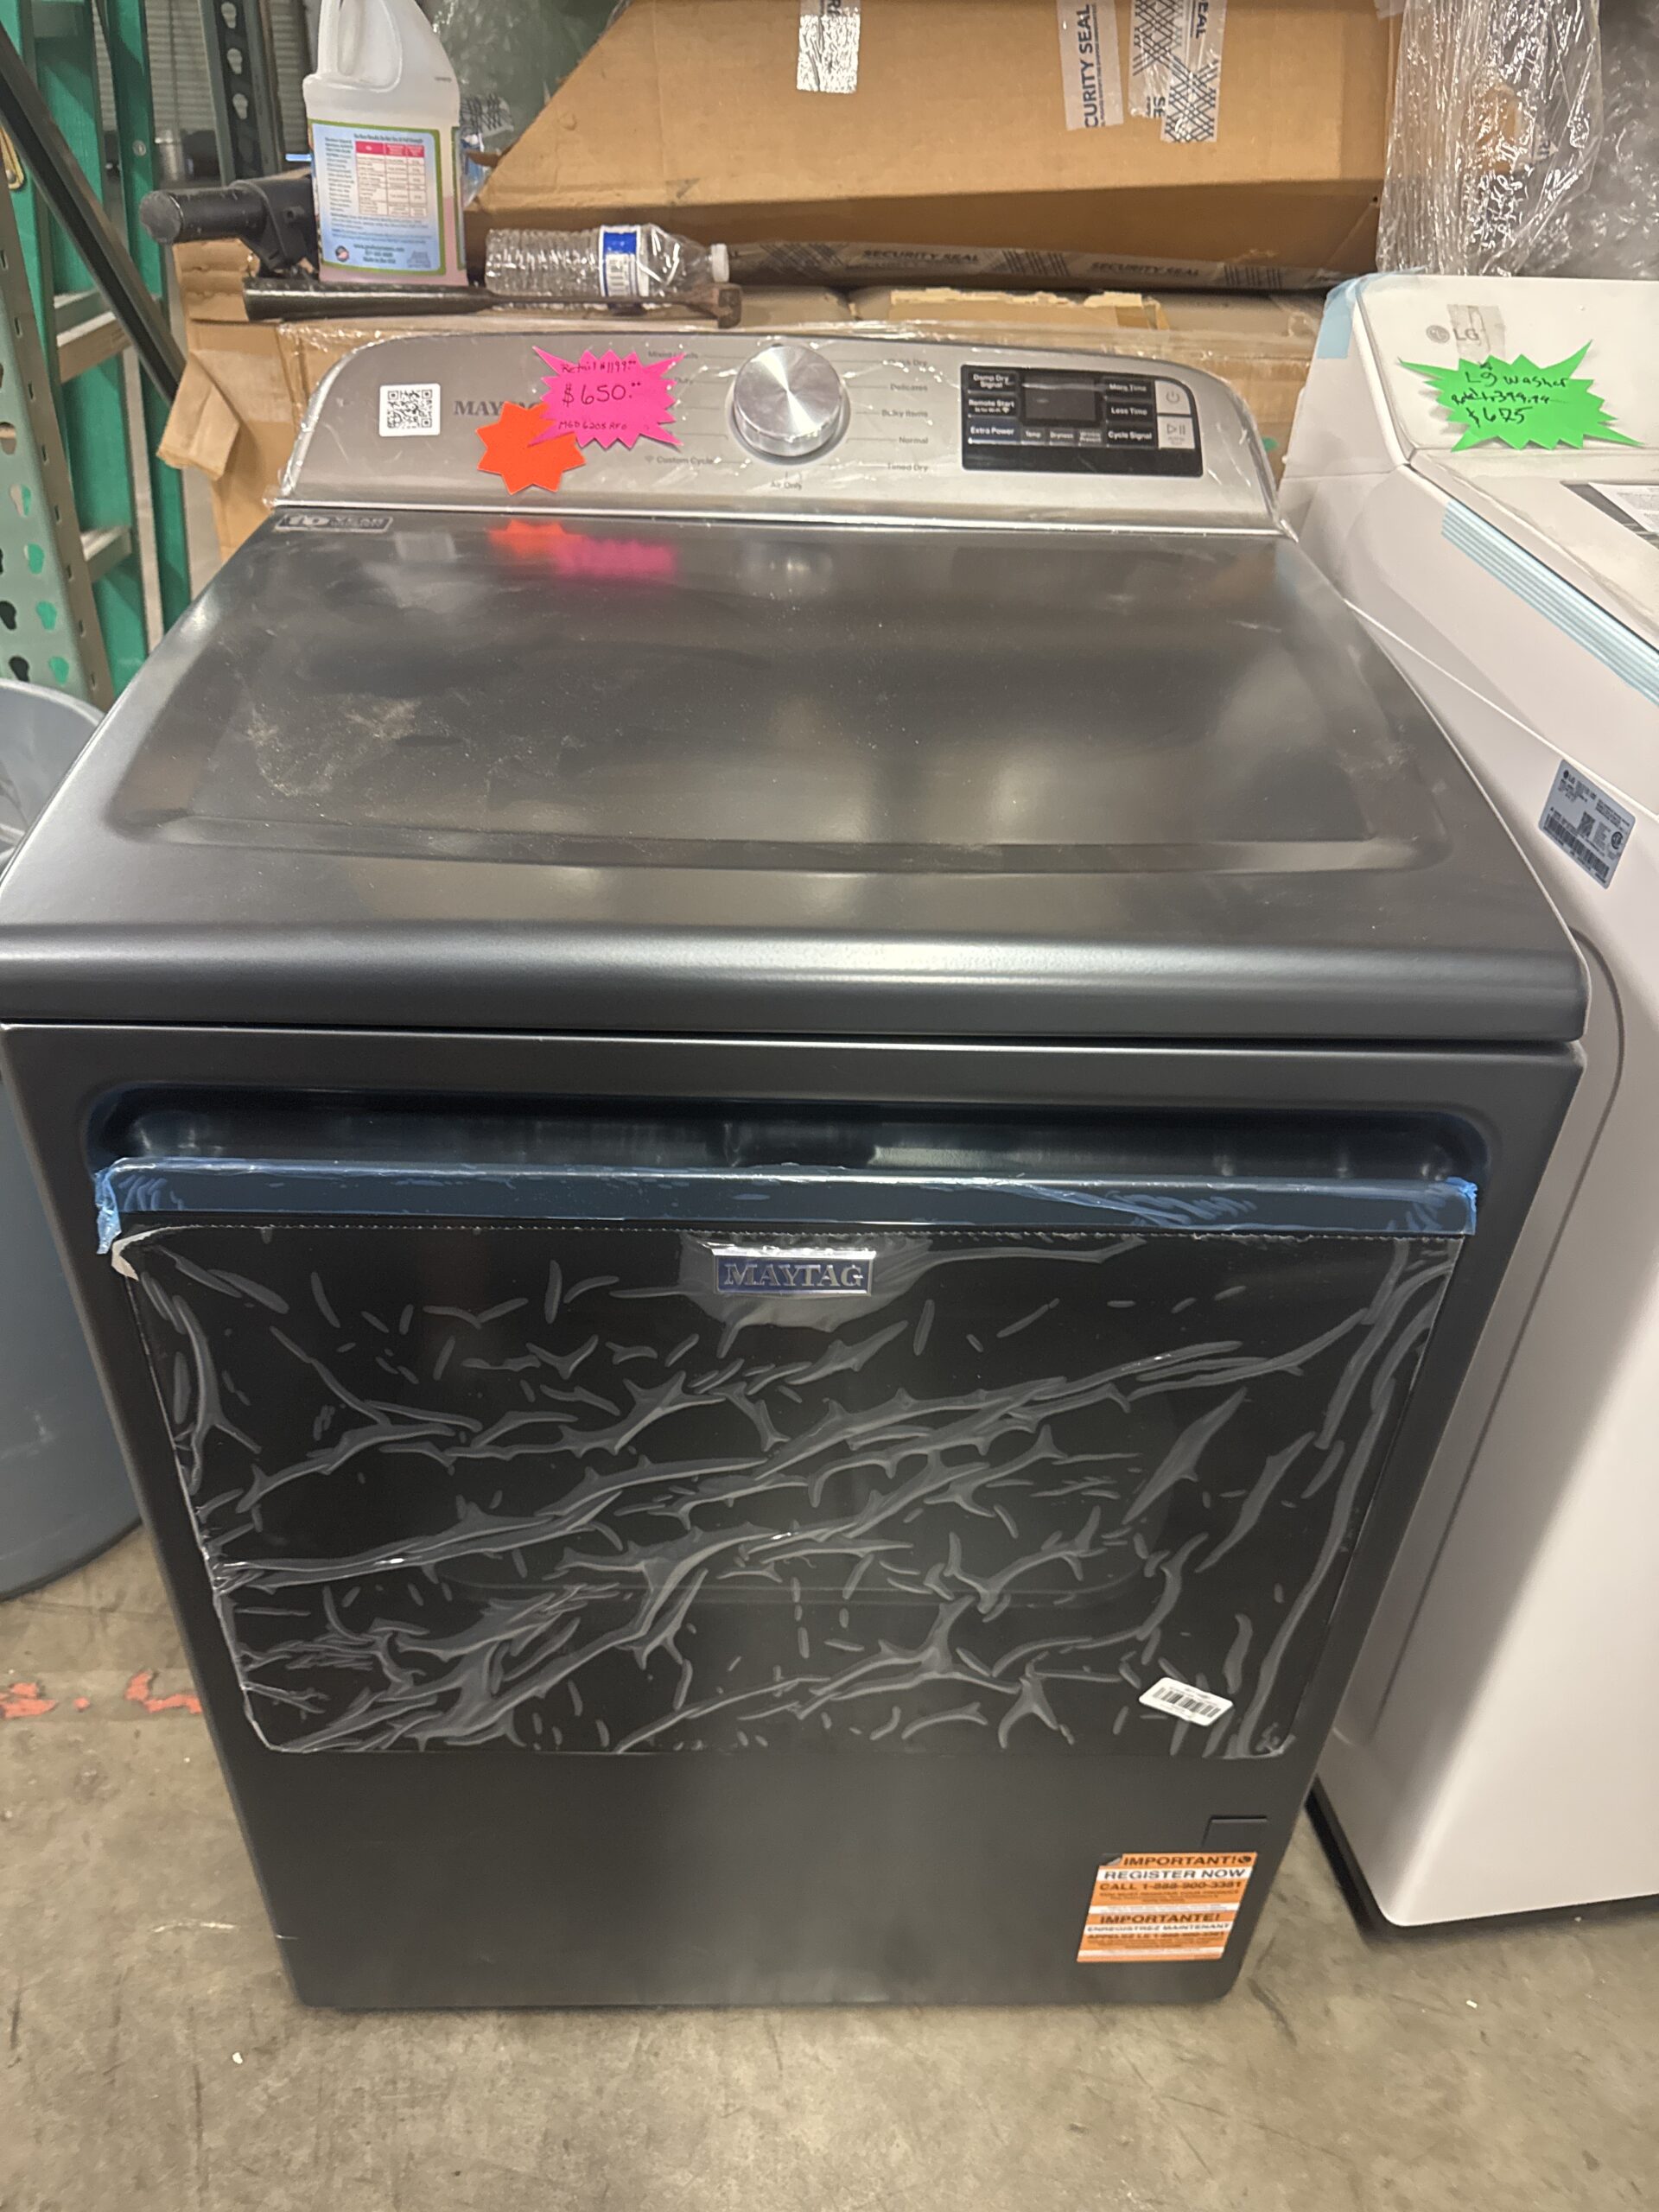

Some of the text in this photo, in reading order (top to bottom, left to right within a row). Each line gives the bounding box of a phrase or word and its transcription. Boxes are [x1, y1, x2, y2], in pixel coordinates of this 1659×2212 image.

[1076, 3, 1094, 54] SEAL
[863, 249, 979, 263] SECURITY SEAL
[1091, 262, 1160, 274] SECURITY
[1452, 327, 1480, 340] LG
[973, 373, 995, 382] Damp
[1109, 383, 1128, 392] More
[968, 398, 1015, 408] Remote Start
[1129, 407, 1147, 416] Time
[970, 426, 1014, 435] Extra Power
[1108, 430, 1152, 442] Cycle Signal
[657, 456, 689, 465] Custom
[723, 1262, 863, 1287] MAYTAG
[1123, 1855, 1236, 1866] IMPORTANT!
[1103, 1868, 1246, 1880] REGISTER NOW
[1099, 1882, 1137, 1891] CALL
[1100, 1913, 1221, 1924] IMPORTANTE!
